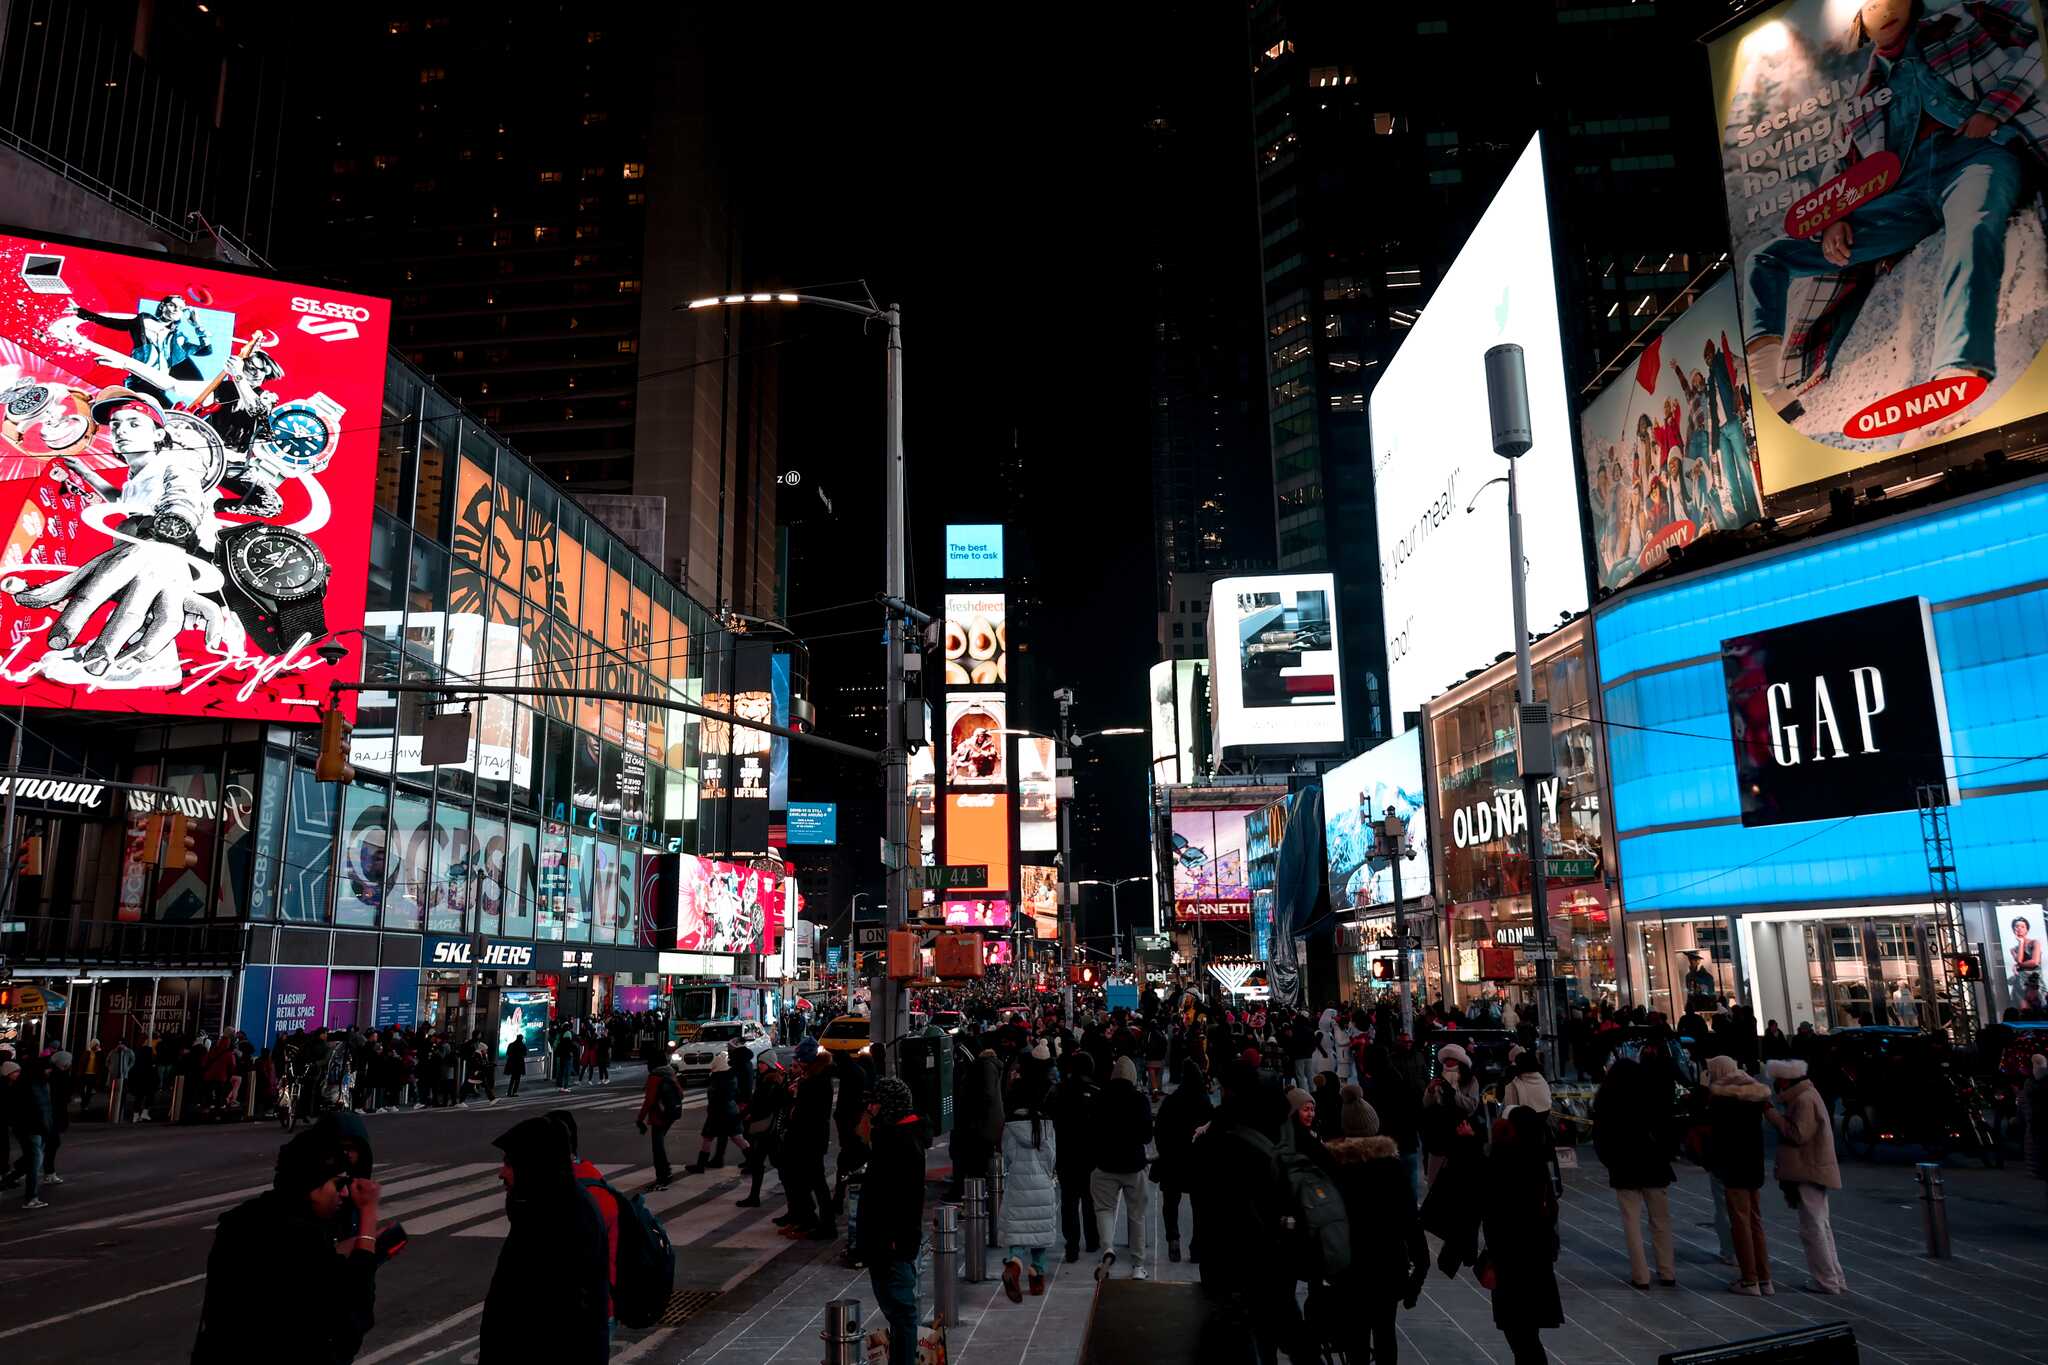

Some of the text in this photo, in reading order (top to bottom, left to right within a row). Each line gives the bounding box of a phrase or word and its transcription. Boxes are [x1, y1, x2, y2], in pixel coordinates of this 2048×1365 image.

[1736, 74, 1860, 148] Secretly
[1740, 86, 1893, 173] loving the
[1744, 133, 1851, 198] holiday
[1747, 180, 1812, 225] rush
[1796, 178, 1847, 219] sorry
[1798, 205, 1831, 236] not
[1857, 381, 1968, 433] OLD NAVY
[950, 552, 969, 560] time
[1644, 543, 1662, 565] OLD
[946, 598, 1004, 612] freshdirect
[182, 632, 324, 702] Style
[1766, 666, 1886, 767] GAP
[735, 787, 768, 798] LIFETIME
[259, 776, 277, 840] NEWS
[1453, 777, 1559, 848] OLD NAY
[929, 868, 942, 886] W
[950, 868, 968, 885] 44
[1550, 863, 1559, 874] W
[1563, 863, 1579, 874] 44
[433, 942, 532, 965] SKEHERS
[144, 993, 181, 1007] FLGSHIP
[276, 1006, 315, 1018] RETAIL SPACE
[277, 993, 307, 1005] FLAGSHIP
[275, 1019, 305, 1032] FOR LEASE
